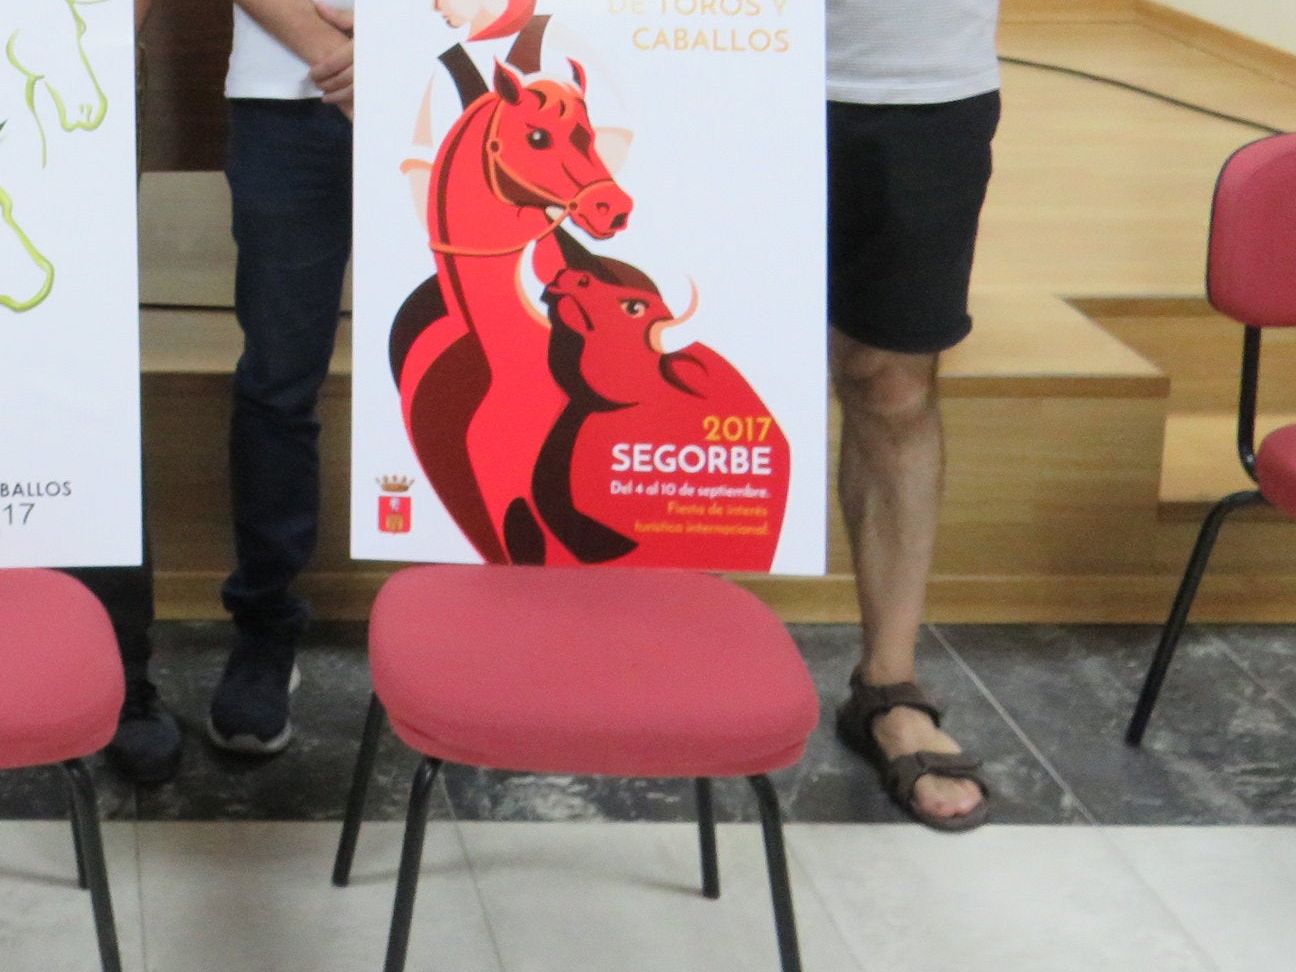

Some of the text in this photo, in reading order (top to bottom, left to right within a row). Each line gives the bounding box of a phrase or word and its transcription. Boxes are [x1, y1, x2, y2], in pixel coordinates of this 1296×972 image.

[631, 26, 791, 53] CABALLOS
[703, 415, 773, 442] 2017
[610, 442, 773, 476] SEGORBE
[610, 480, 633, 495] Del
[635, 482, 644, 494] 4
[645, 480, 659, 495] al
[661, 482, 677, 496] 10
[678, 480, 695, 497] de
